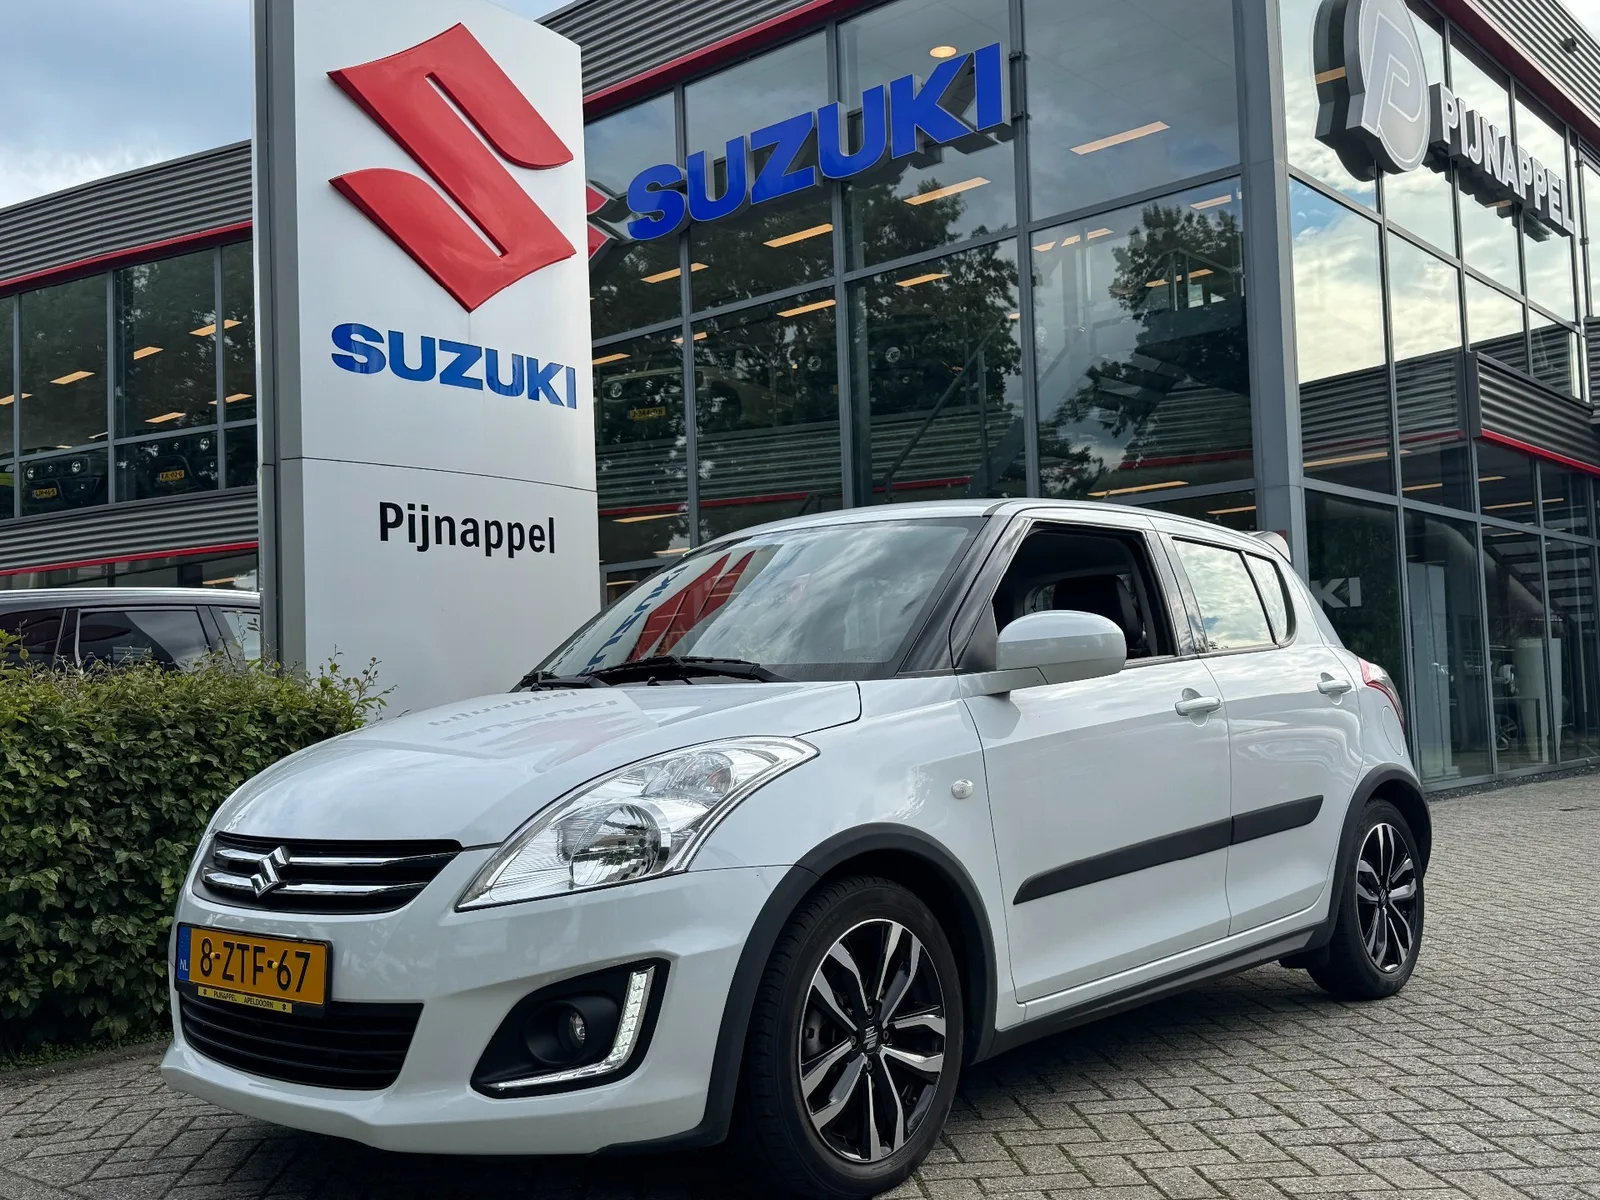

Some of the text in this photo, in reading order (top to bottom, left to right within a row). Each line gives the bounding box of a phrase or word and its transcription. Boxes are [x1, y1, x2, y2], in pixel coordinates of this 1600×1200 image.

[626, 42, 1007, 242] SUZUKI
[1437, 83, 1574, 235] PIJNAPPEL
[331, 322, 577, 409] SUZUKI
[379, 501, 555, 558] Pijnappel
[179, 937, 312, 993] NL 8-ZTF-67
[243, 996, 274, 1009] APELDOORN
